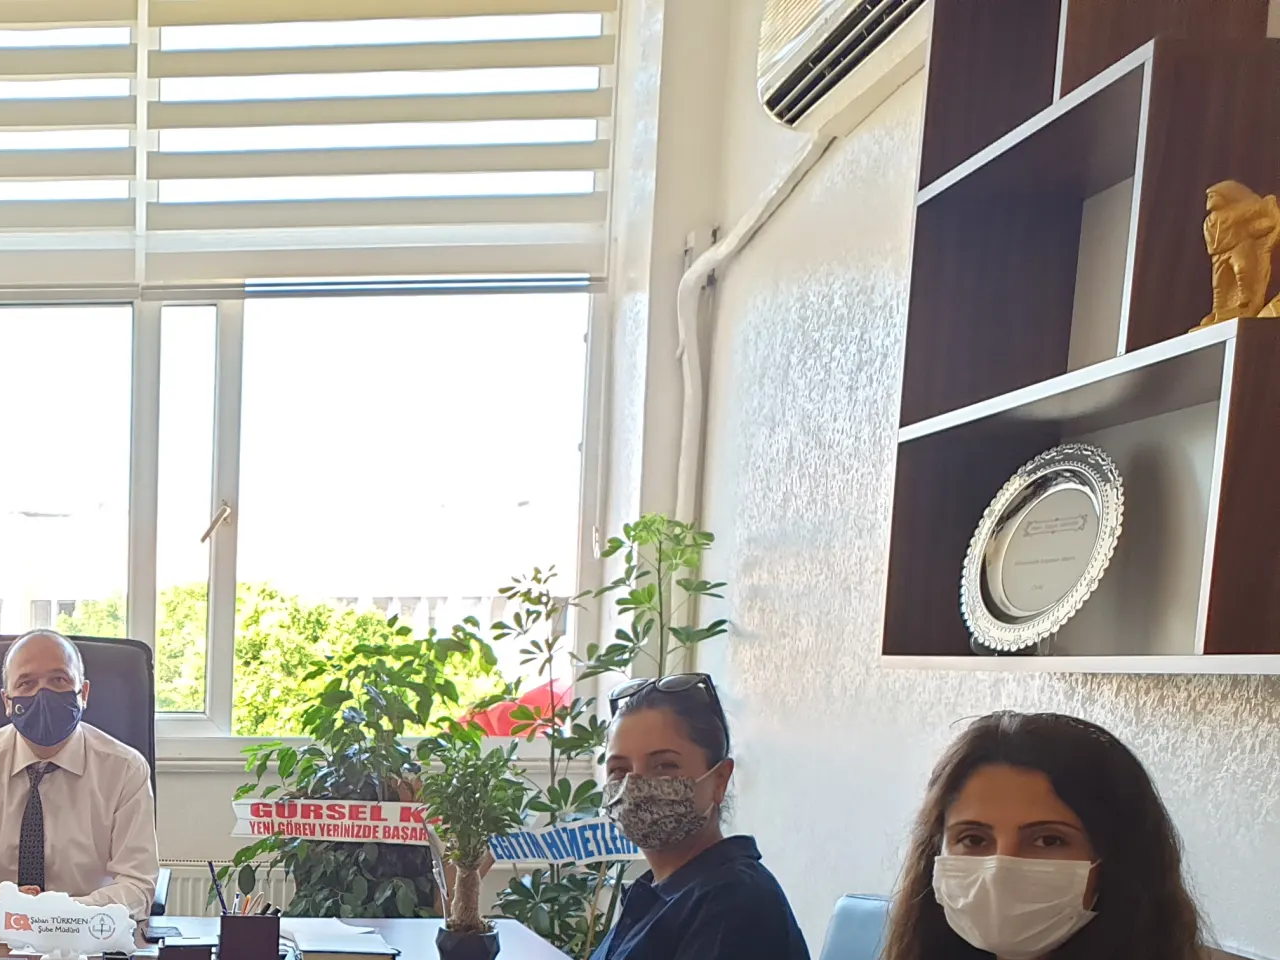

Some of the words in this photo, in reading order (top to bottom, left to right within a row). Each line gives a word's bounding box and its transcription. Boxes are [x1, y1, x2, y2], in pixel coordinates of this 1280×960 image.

[250, 800, 388, 821] GÜRSEL
[249, 820, 275, 836] YENİ
[278, 820, 316, 836] GÖREV
[319, 821, 380, 839] YERİNİZDE
[51, 915, 89, 925] TÜRKMEN
[38, 925, 54, 934] Şube
[55, 926, 80, 934] Müdürü
